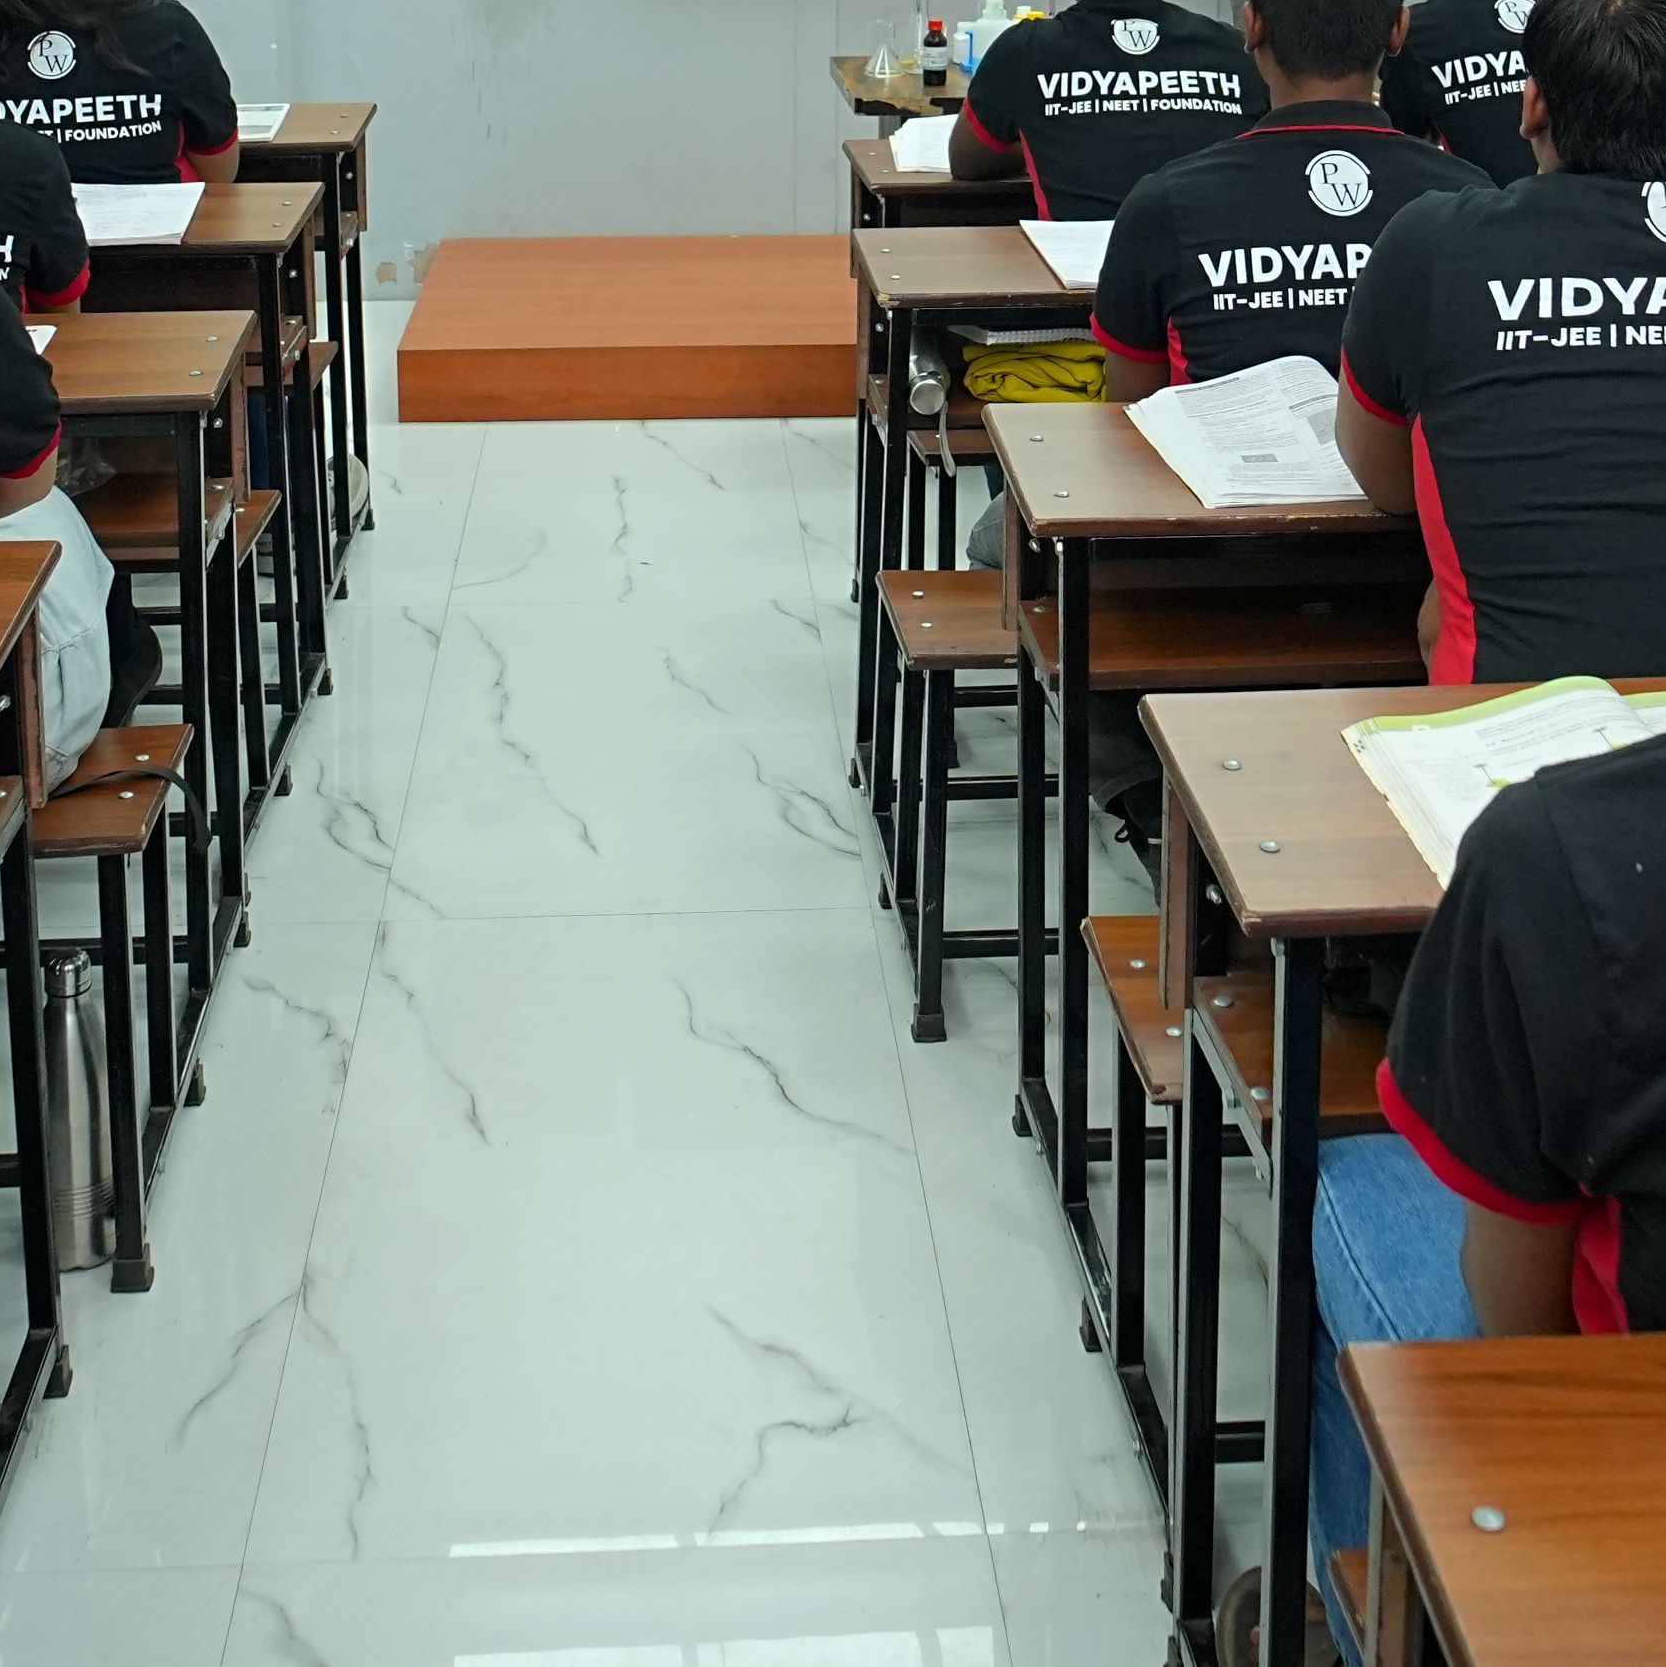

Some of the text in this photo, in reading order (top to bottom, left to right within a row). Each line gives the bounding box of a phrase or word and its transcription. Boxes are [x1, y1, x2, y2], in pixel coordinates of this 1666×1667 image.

[38, 39, 68, 74] PW
[1431, 50, 1527, 89] VIDYA
[1037, 69, 1242, 100] VIDYAPEETH
[1444, 79, 1527, 105] IIT-JEE NEE
[1044, 98, 1243, 117] IIT-JEE NEET FOUNDATION
[65, 119, 163, 143] FOUNDATION
[1320, 162, 1363, 208] PW
[1198, 243, 1372, 288] VIDYAP
[1213, 287, 1348, 311] IIT-JEE NEET
[1496, 326, 1601, 352] IIT-JEE
